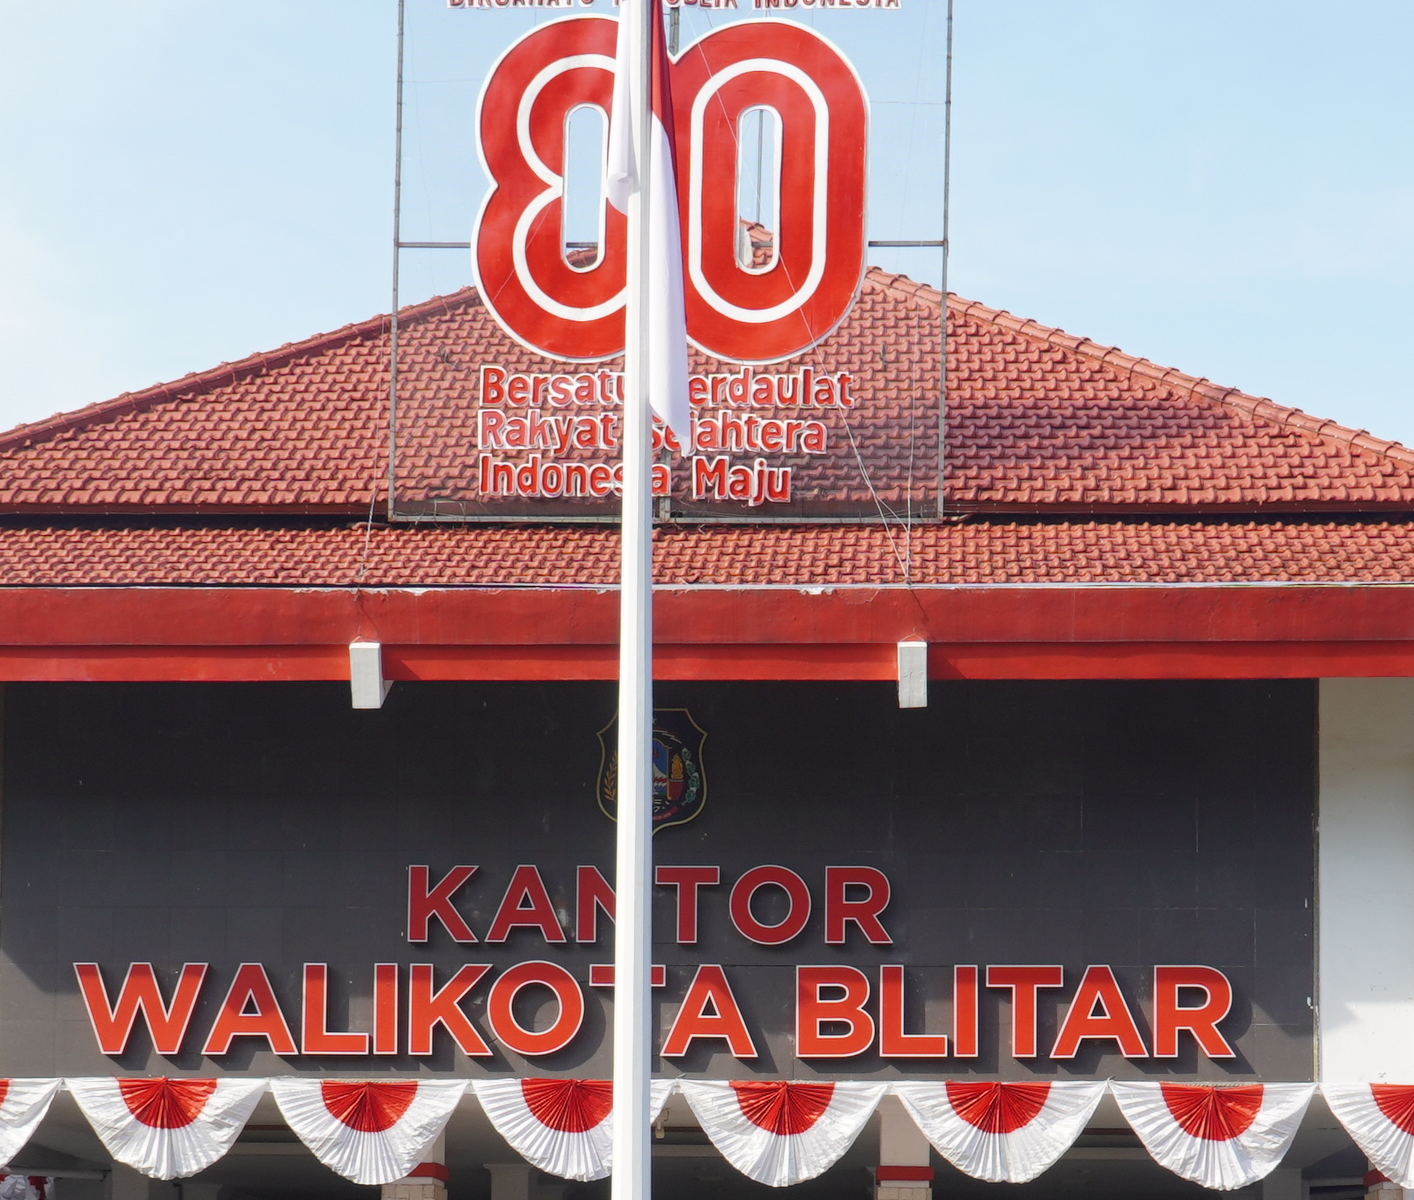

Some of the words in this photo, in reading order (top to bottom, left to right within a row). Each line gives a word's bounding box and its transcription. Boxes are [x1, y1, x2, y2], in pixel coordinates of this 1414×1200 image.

[471, 15, 870, 363] 80
[688, 366, 854, 408] erdaulat
[478, 409, 618, 456] Rakyat
[478, 454, 671, 498] Indonea
[693, 456, 792, 506] Maju
[408, 864, 893, 944] KANTOR
[795, 964, 1237, 1058] BLITAR
